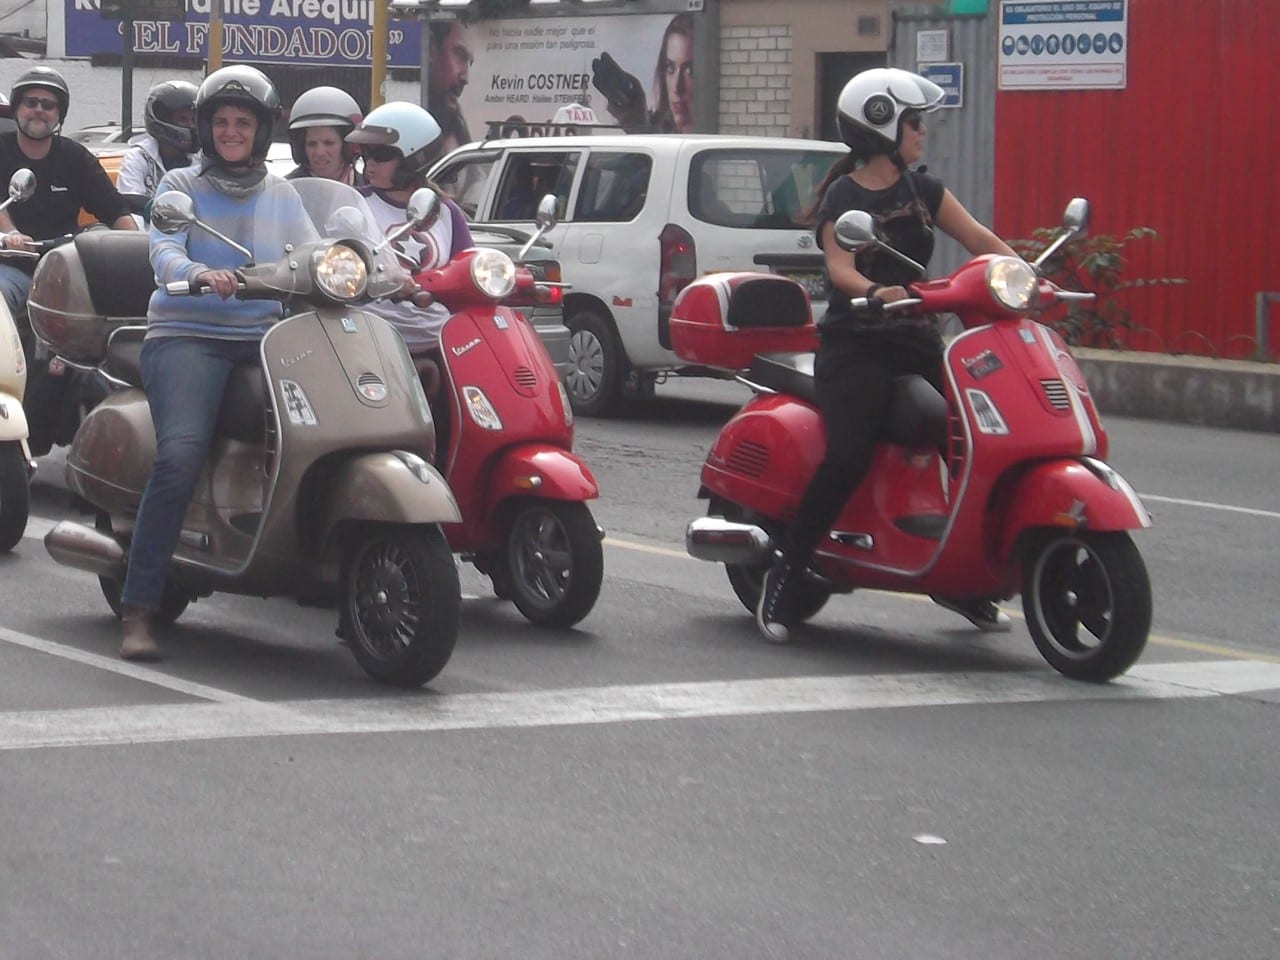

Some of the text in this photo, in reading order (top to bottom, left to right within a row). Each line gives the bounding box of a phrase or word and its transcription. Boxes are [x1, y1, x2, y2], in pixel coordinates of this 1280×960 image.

[491, 73, 590, 90] Kevin COSTNER
[565, 109, 593, 122] TAXI
